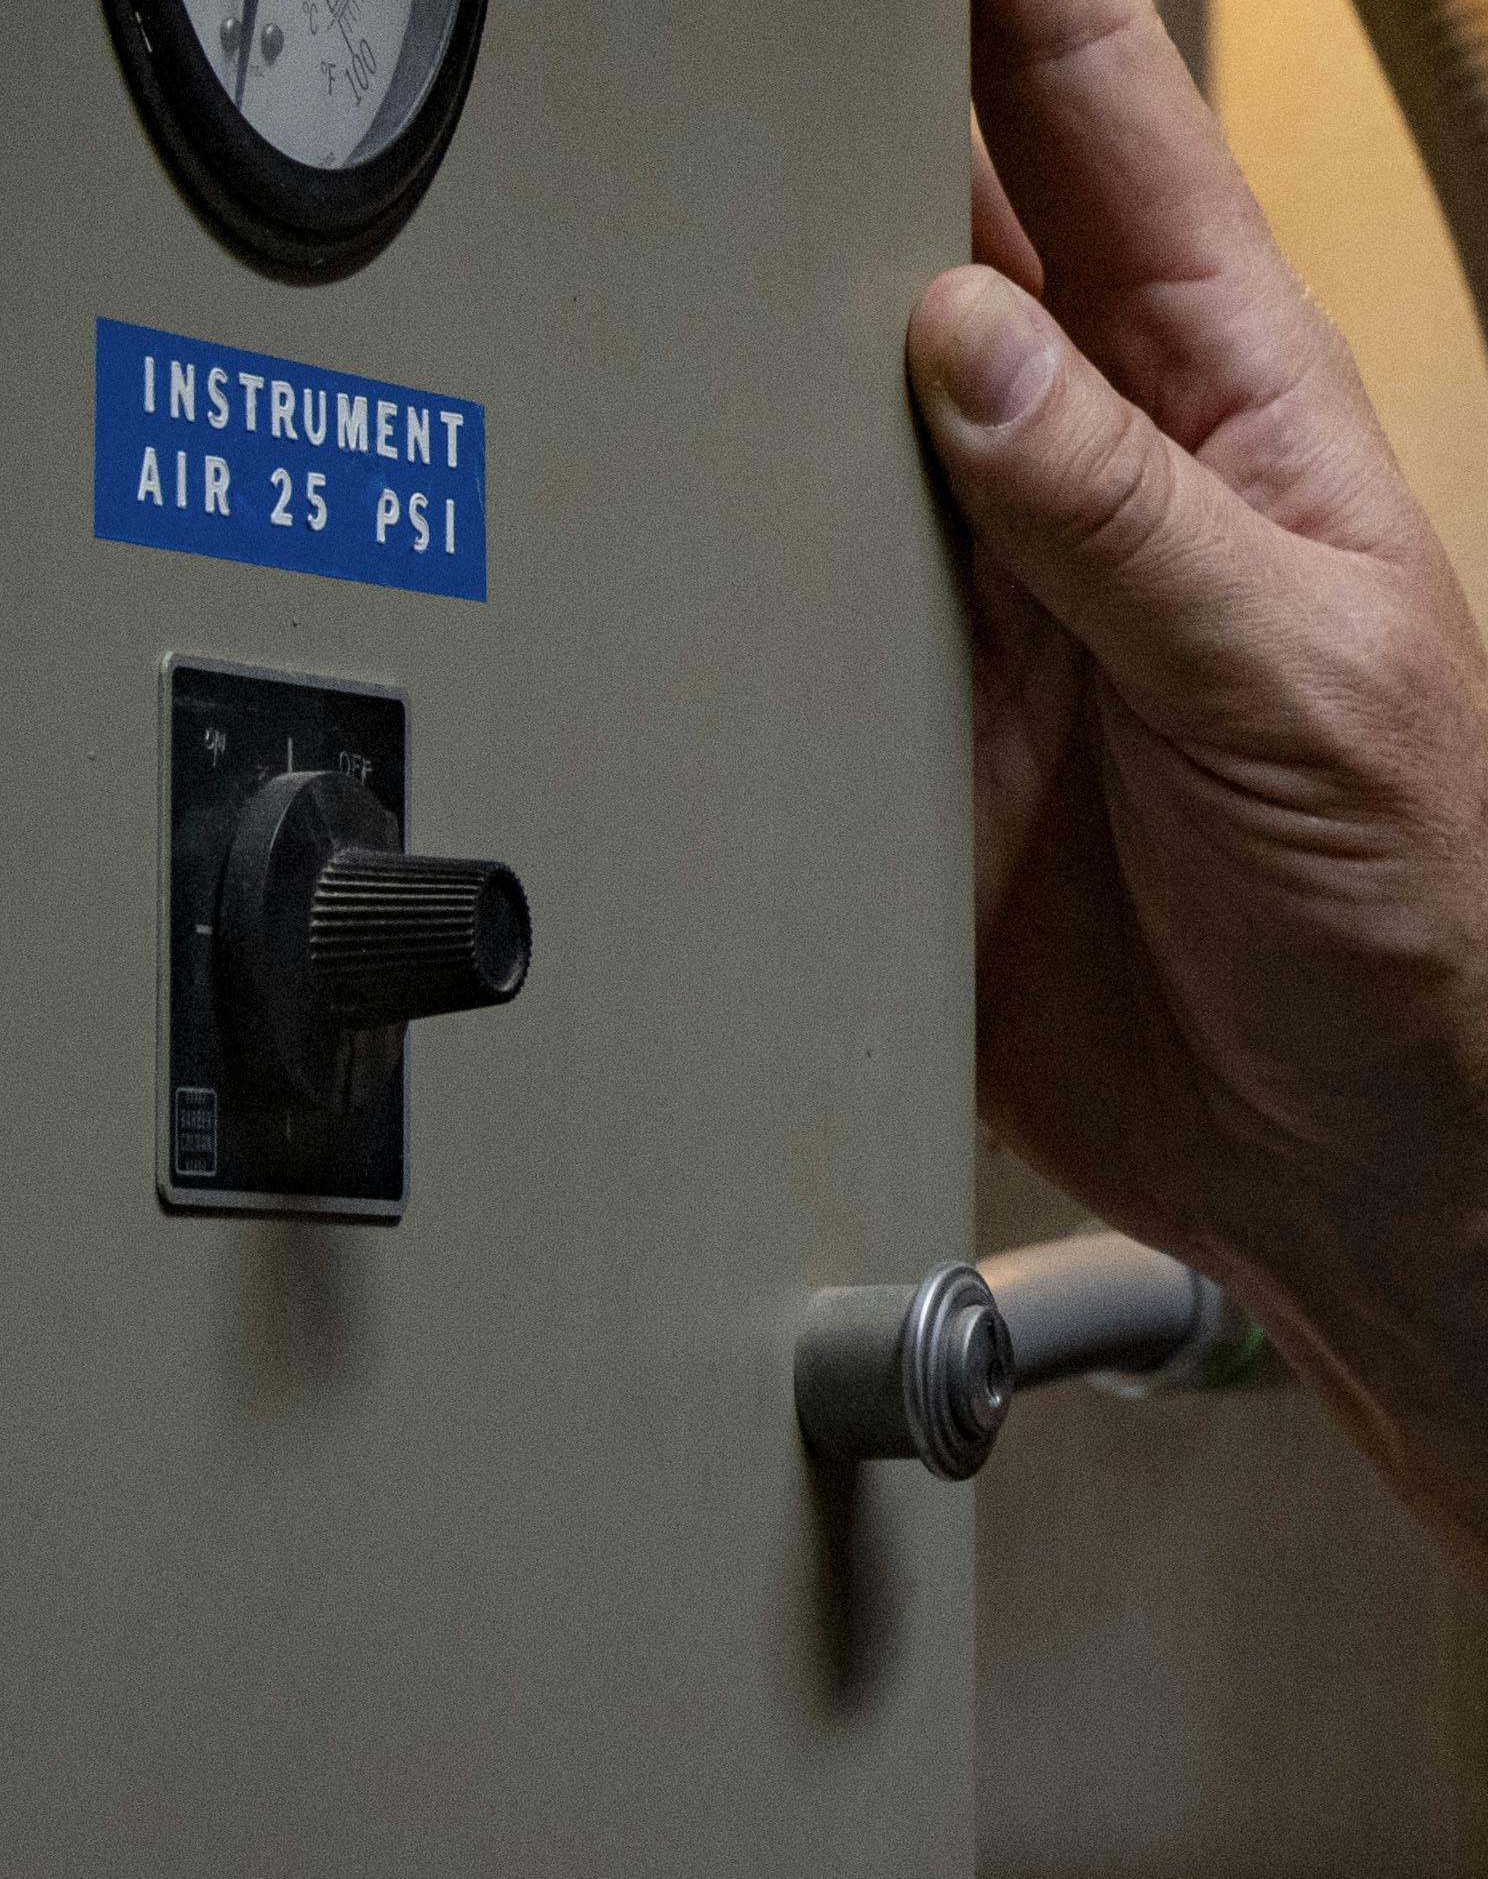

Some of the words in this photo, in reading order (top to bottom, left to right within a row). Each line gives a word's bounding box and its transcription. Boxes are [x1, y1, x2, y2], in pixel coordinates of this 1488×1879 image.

[345, 37, 377, 107] 100
[143, 356, 465, 469] INSTRUMENT
[137, 446, 232, 517] AIR
[269, 467, 328, 532] 25
[375, 488, 456, 555] PSI
